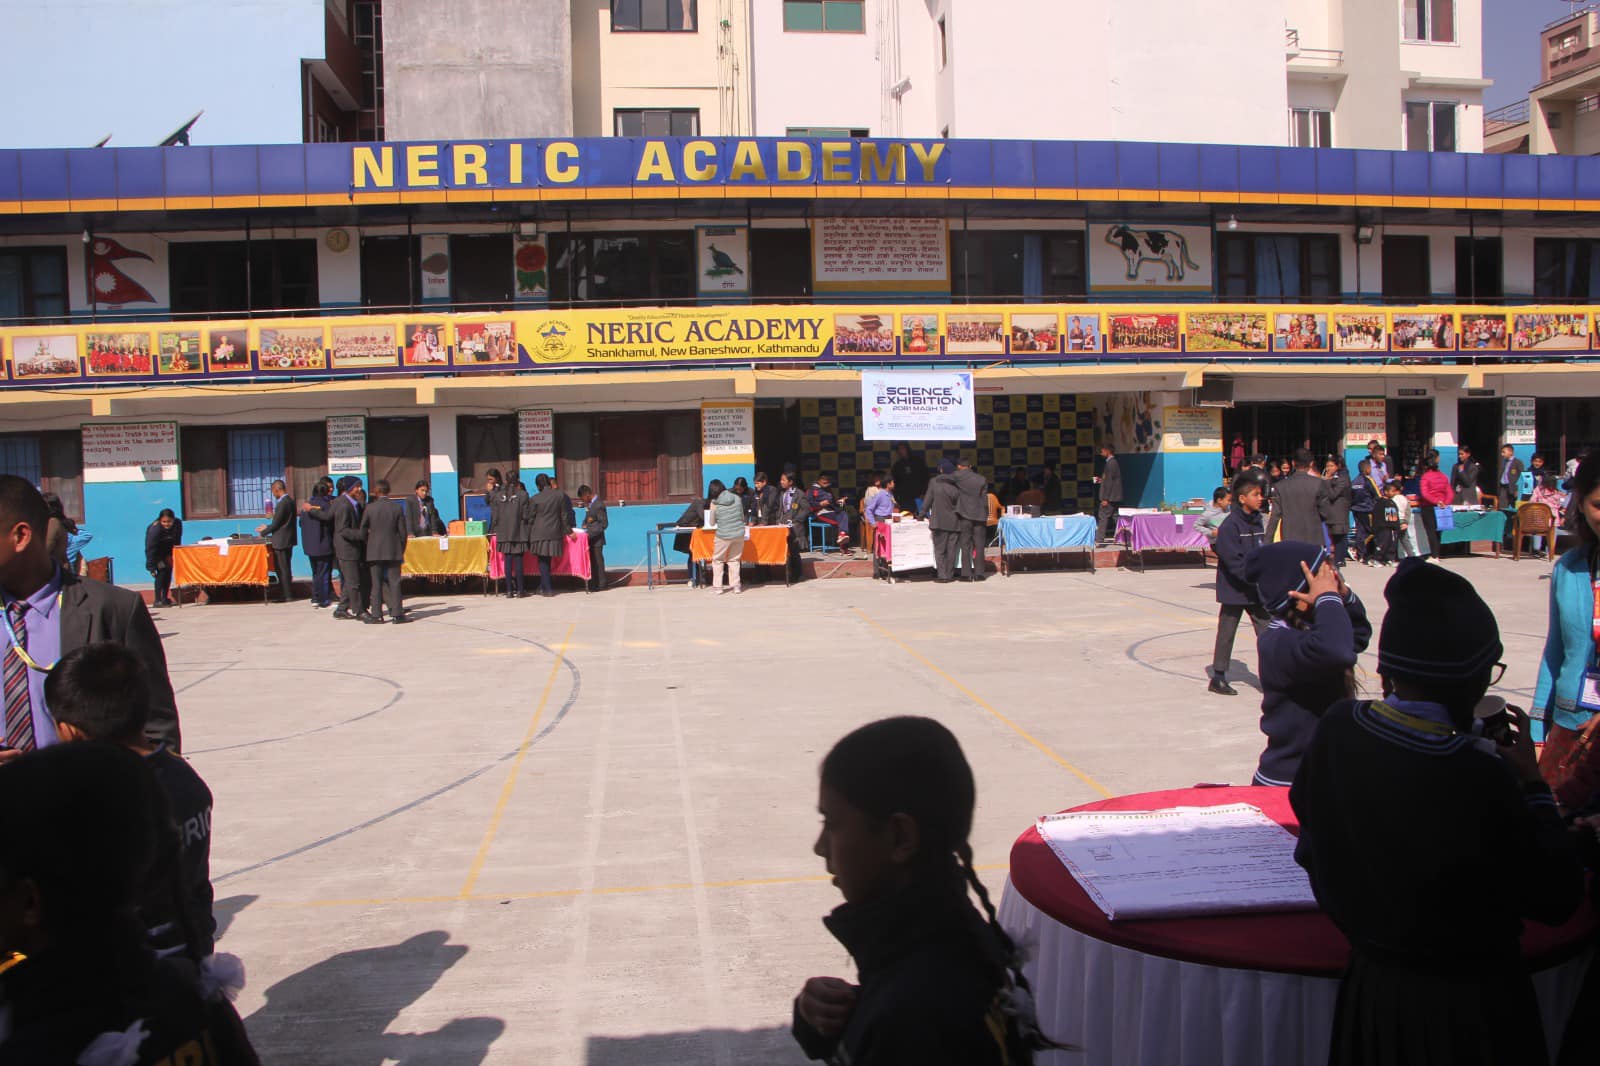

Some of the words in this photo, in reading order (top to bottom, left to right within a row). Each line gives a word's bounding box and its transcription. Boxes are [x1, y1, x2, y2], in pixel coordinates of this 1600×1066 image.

[353, 142, 580, 188] NERIC
[636, 140, 946, 184] ACADEMY
[586, 321, 675, 344] NERIC
[684, 318, 824, 343] ACADEMY
[587, 347, 658, 358] Shankhamul,
[661, 346, 686, 356] New
[690, 345, 754, 355] Baneshwor,
[757, 343, 819, 353] Kathmandu
[886, 387, 952, 396] SCIENCE
[876, 396, 962, 405] EXHIBITION
